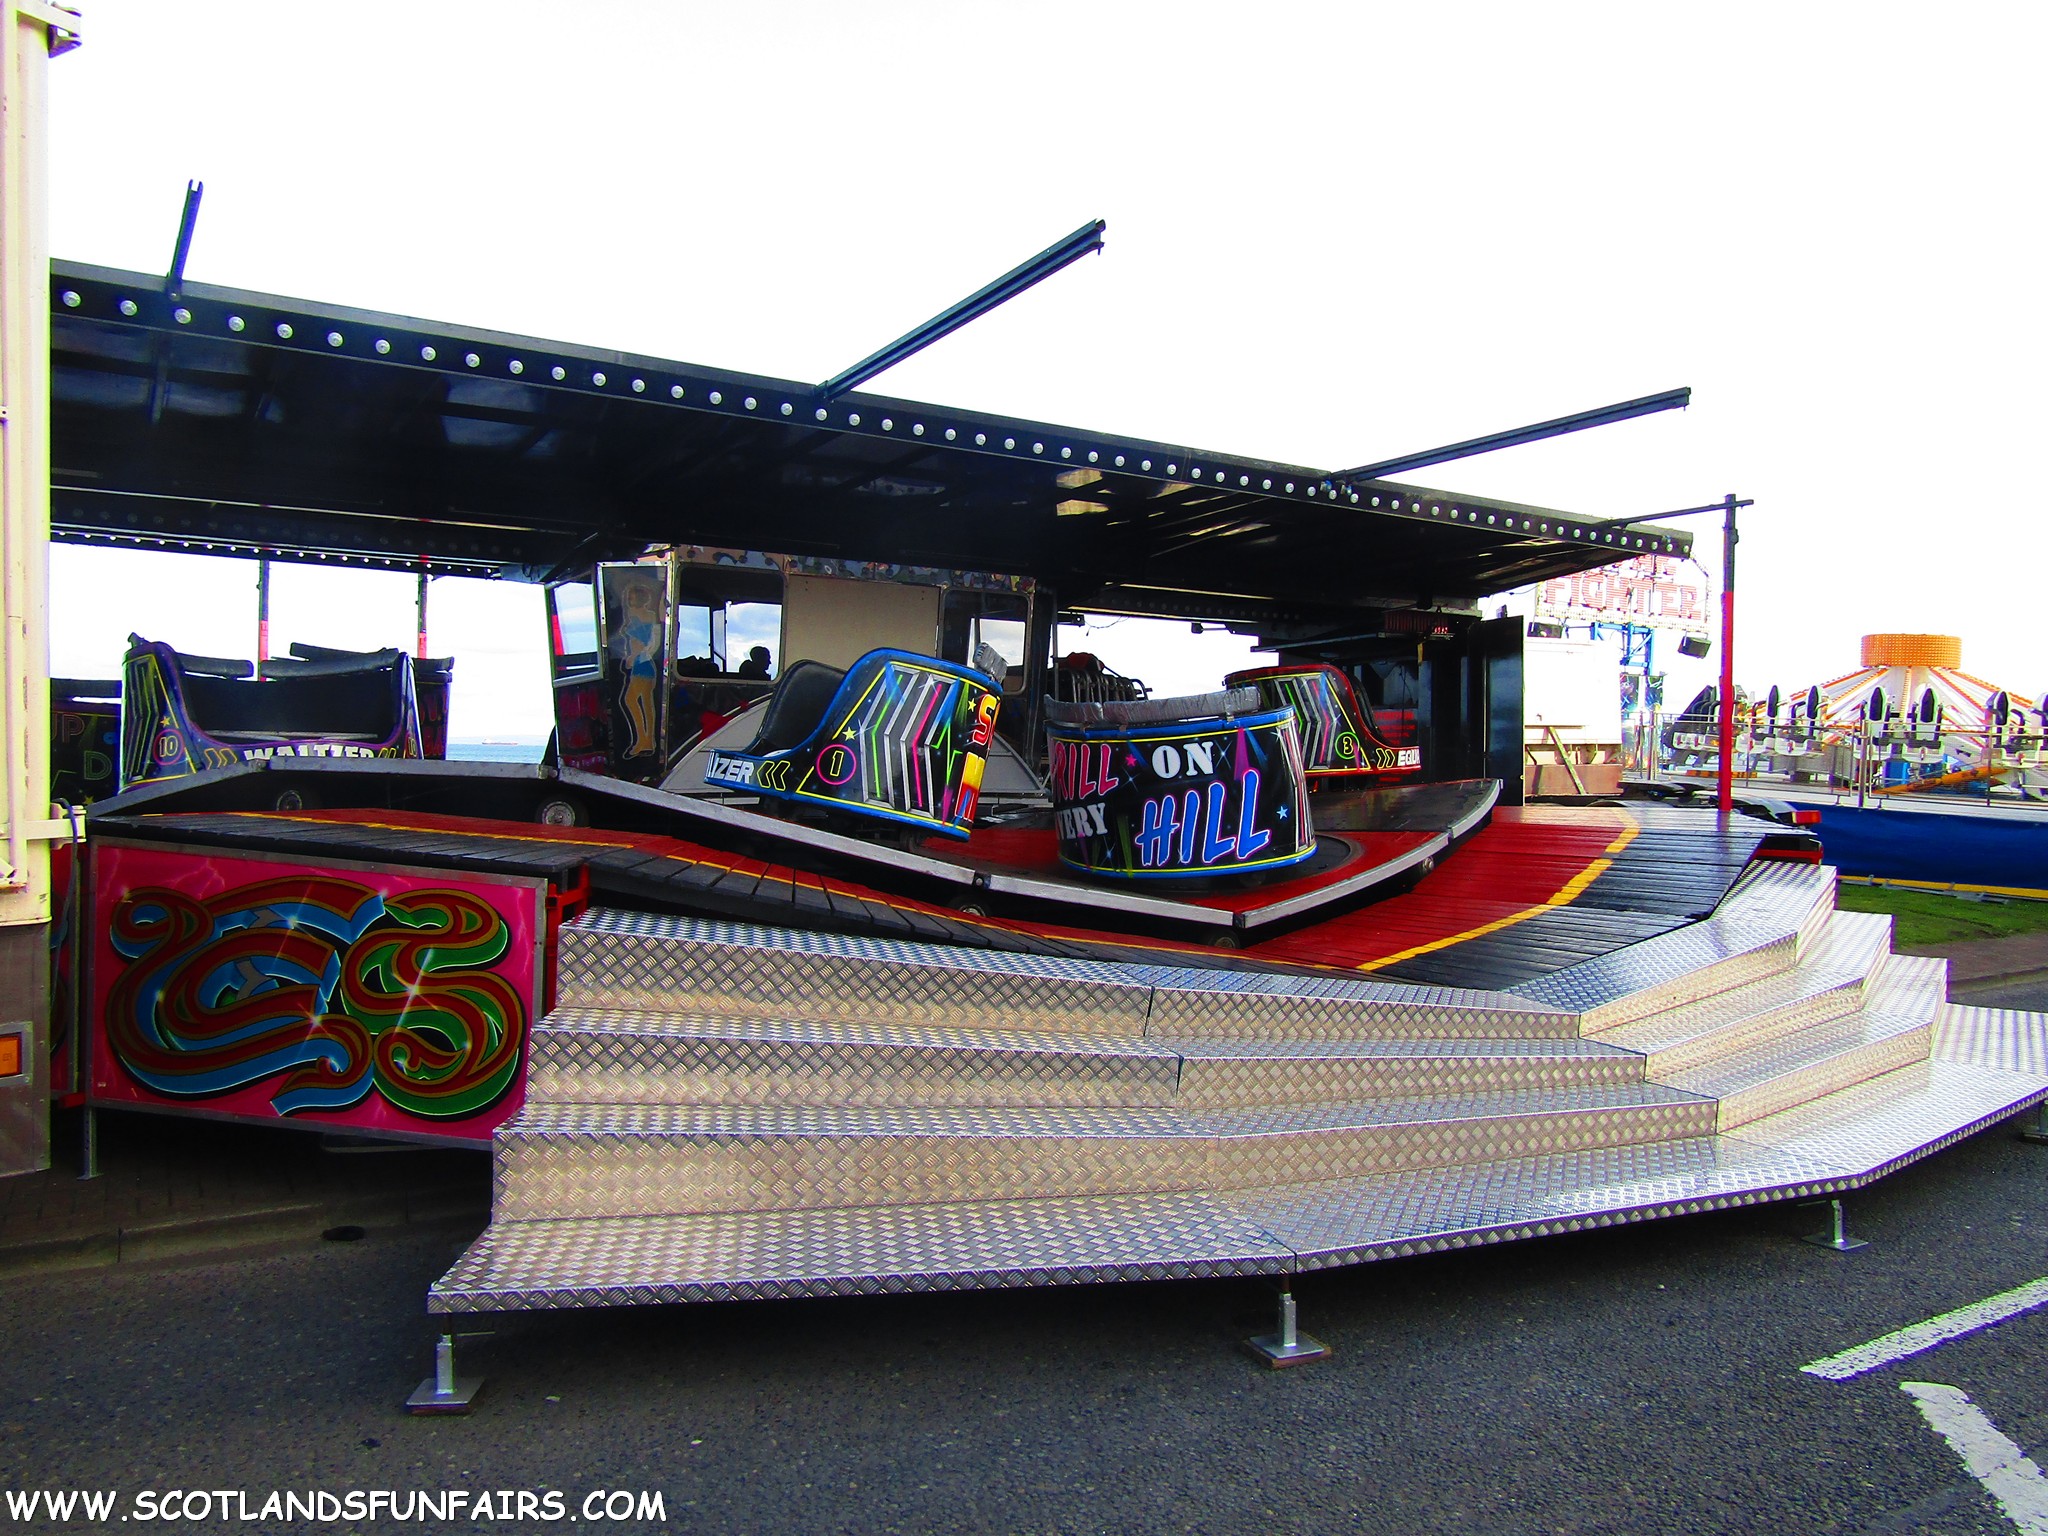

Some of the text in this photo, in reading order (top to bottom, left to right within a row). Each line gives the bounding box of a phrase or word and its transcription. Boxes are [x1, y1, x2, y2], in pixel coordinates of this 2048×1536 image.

[1544, 574, 1702, 621] FIGHTER
[159, 735, 179, 758] 10
[1151, 740, 1215, 780] ON
[1341, 736, 1353, 755] 3
[830, 750, 844, 778] 1
[1134, 769, 1272, 868] HILL
